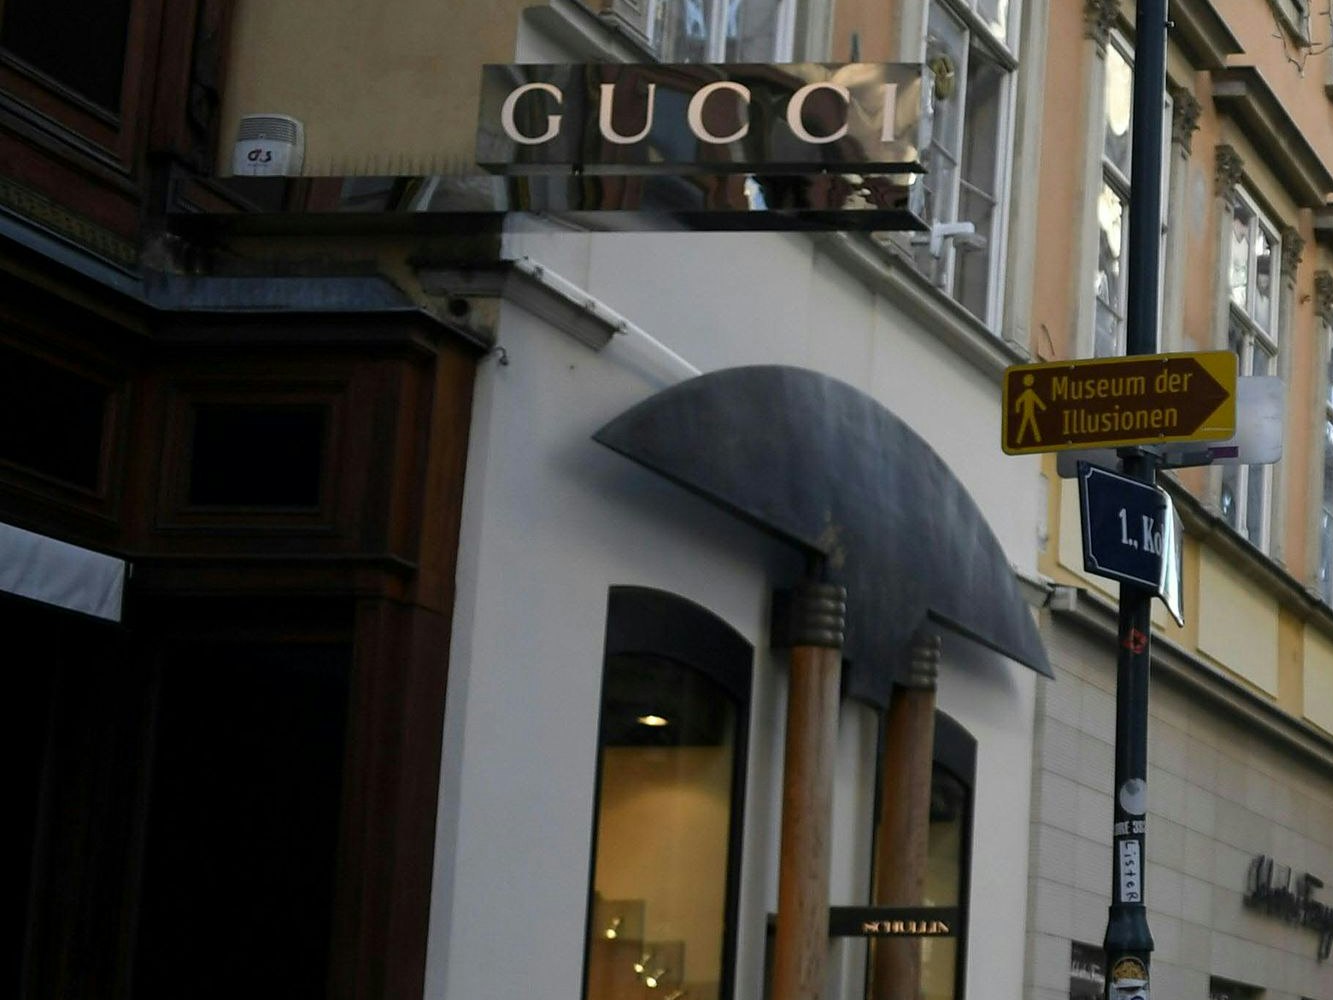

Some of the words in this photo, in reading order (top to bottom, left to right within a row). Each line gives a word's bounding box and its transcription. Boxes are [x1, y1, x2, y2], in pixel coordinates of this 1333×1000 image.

[501, 81, 897, 144] GUCCI
[1052, 373, 1146, 402] Museum
[1155, 369, 1193, 394] der
[1063, 405, 1178, 435] Illusionen
[1119, 508, 1139, 548] 1.,
[860, 919, 950, 934] SCHULLIN
